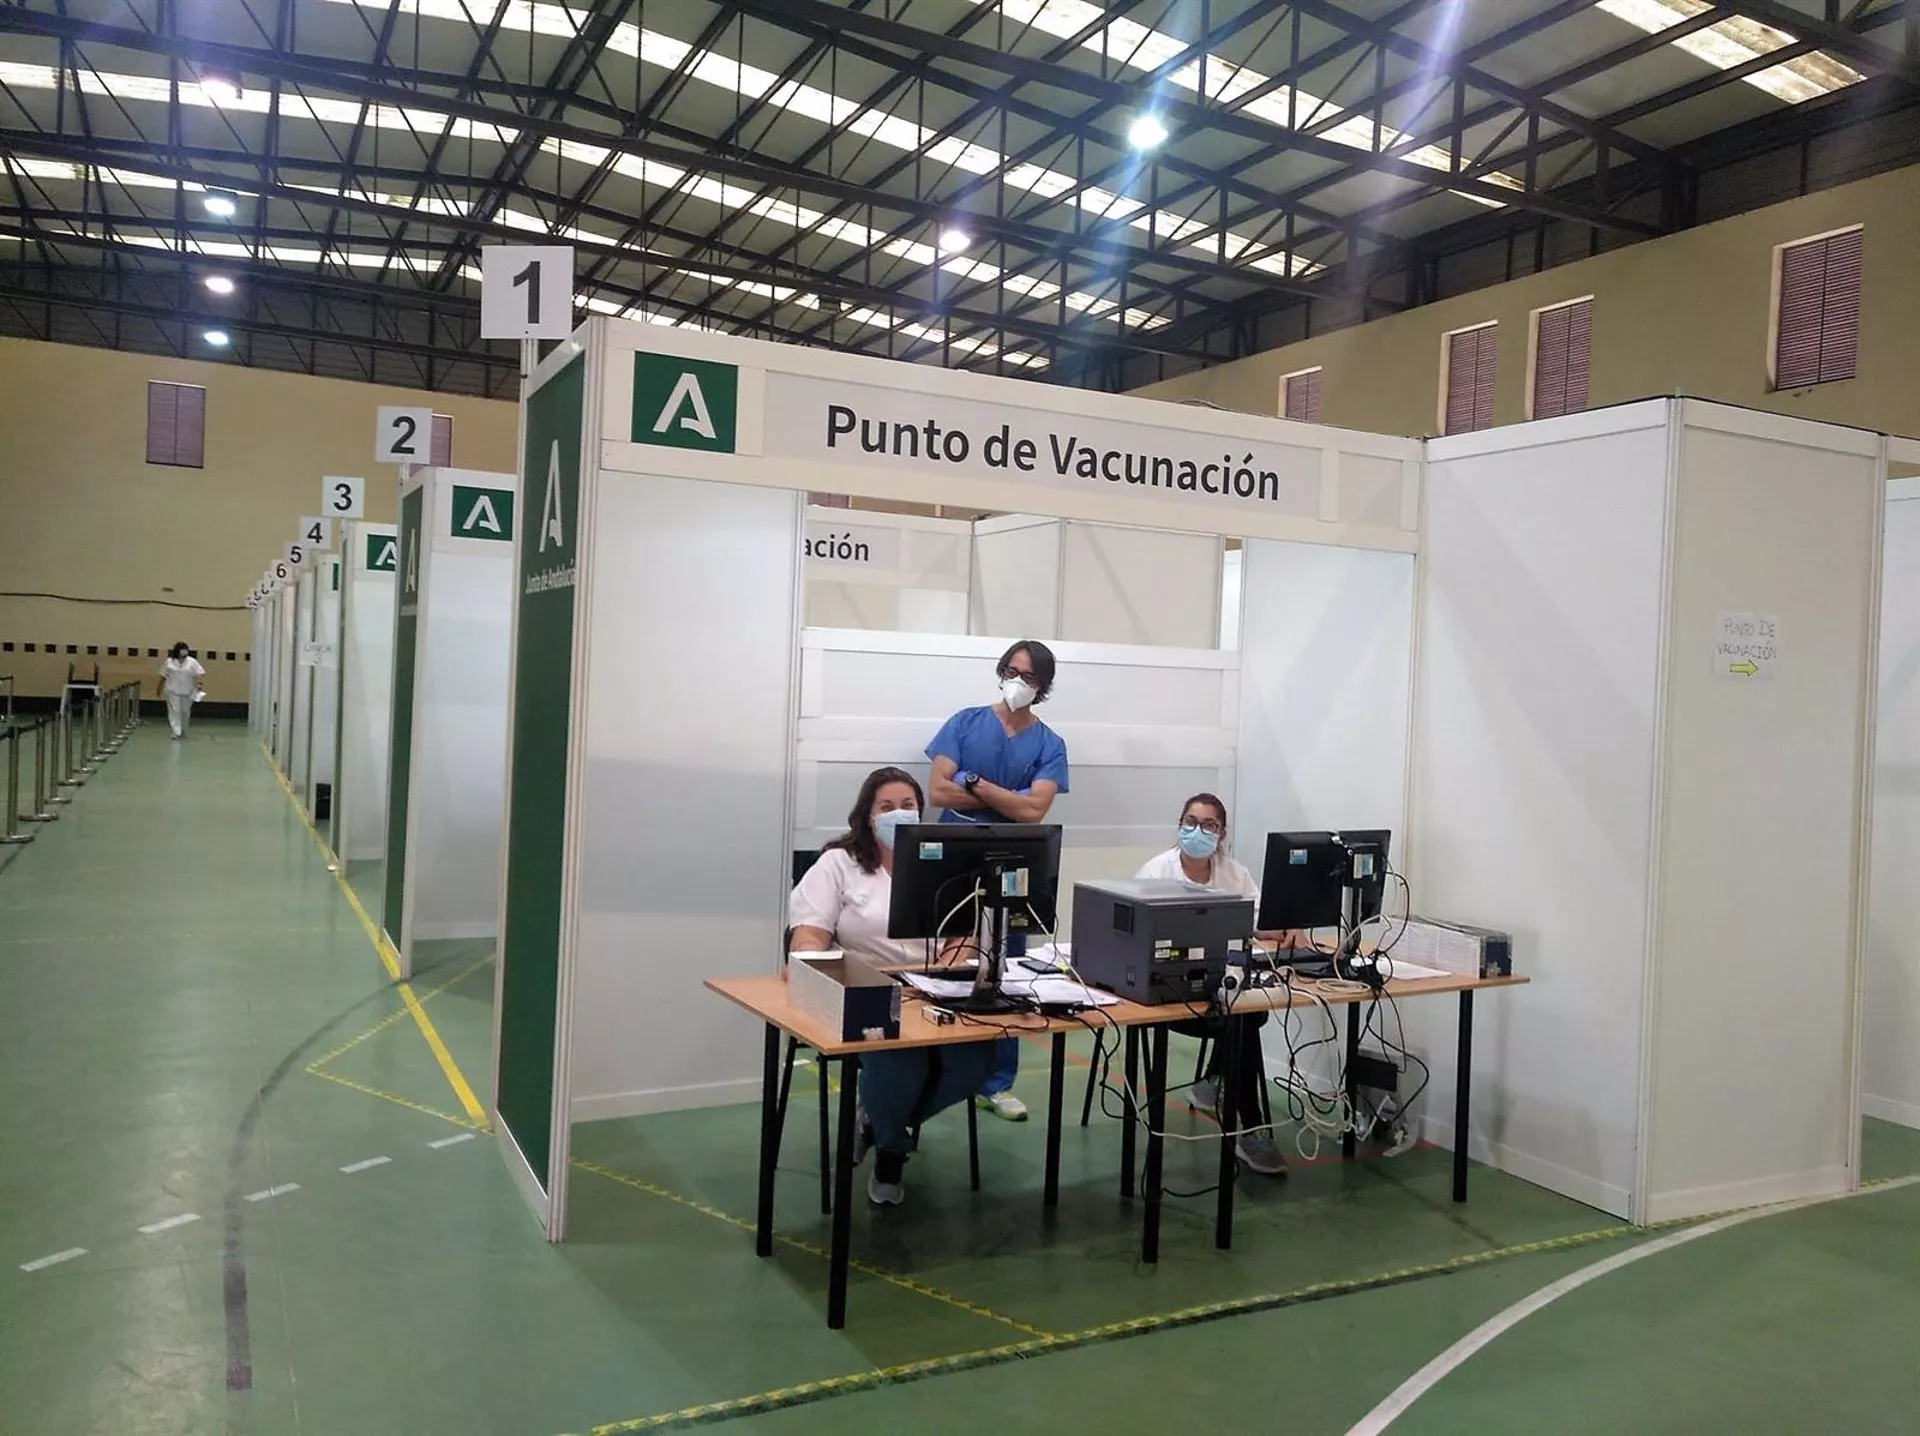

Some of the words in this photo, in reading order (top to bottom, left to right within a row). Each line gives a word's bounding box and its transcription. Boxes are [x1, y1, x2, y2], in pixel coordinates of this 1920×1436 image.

[513, 261, 540, 324] 1
[390, 415, 416, 455] 2
[827, 405, 970, 462] Punto
[983, 424, 1037, 471] de
[1049, 433, 1280, 501] Vacunación
[333, 483, 353, 511] 3
[307, 522, 323, 544] 4
[289, 545, 302, 564] 5
[276, 563, 287, 579] 6
[1758, 618, 1776, 638] DE
